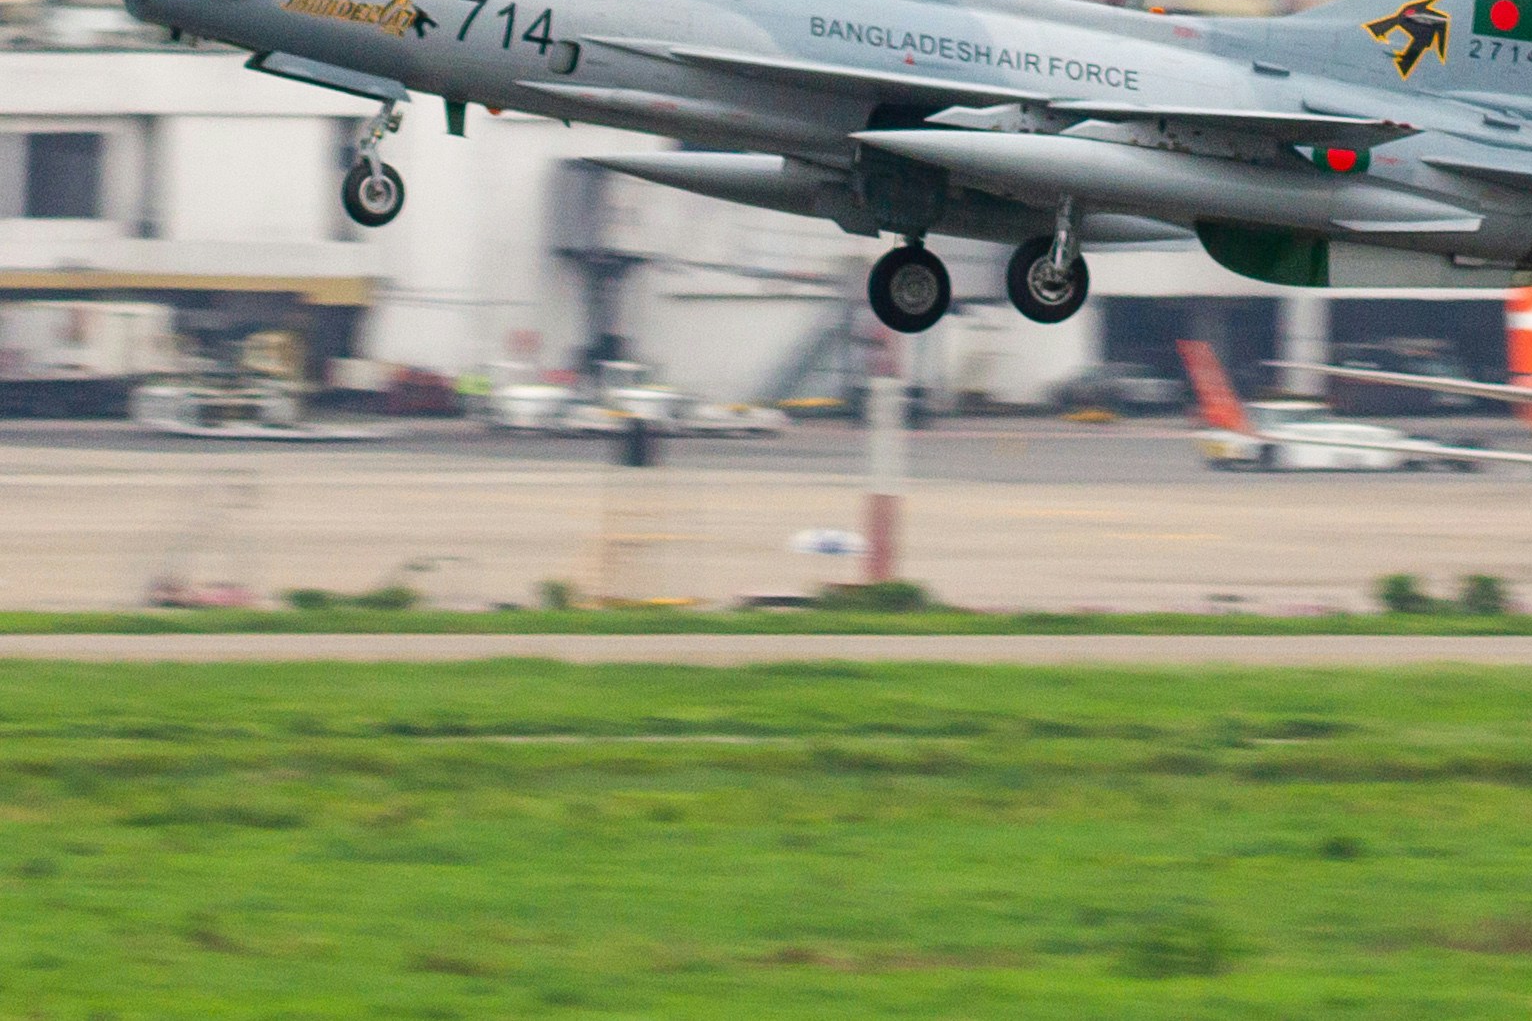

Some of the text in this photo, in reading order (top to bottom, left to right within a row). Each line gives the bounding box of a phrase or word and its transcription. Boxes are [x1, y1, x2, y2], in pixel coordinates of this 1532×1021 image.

[810, 15, 1138, 91] BANGLADESH AIR FORCE
